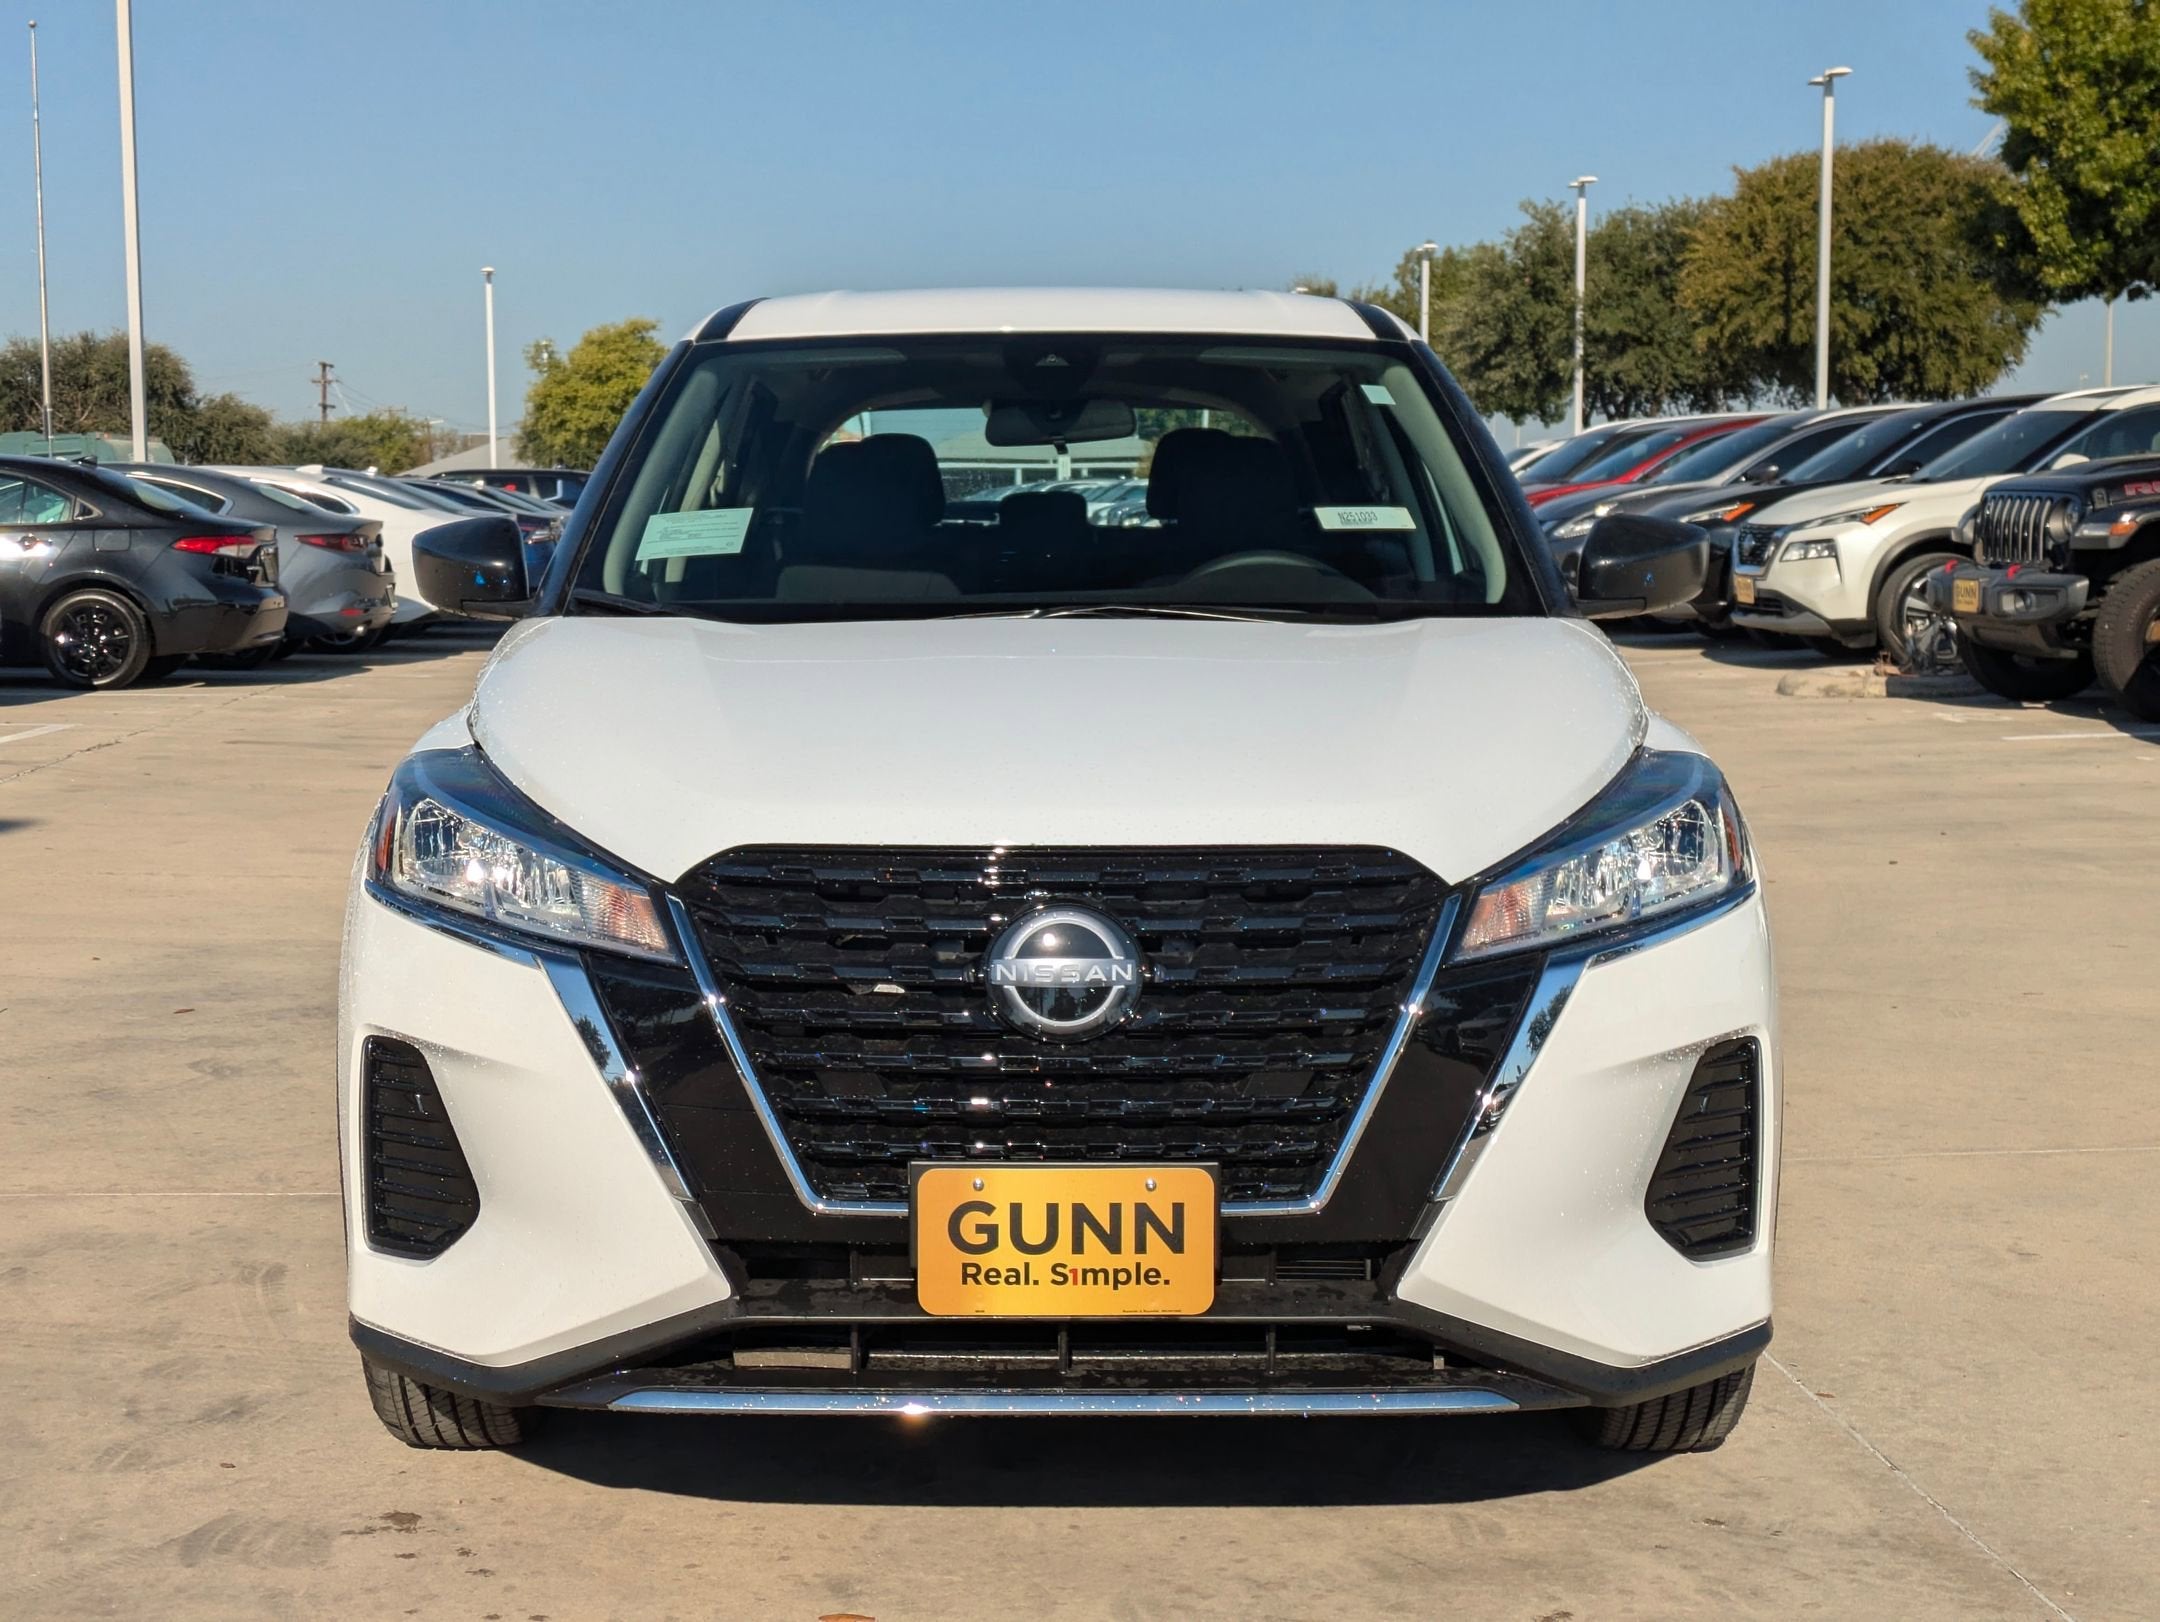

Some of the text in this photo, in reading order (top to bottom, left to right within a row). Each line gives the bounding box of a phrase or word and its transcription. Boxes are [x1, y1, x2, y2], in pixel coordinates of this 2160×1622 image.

[995, 963, 1133, 982] NISSAN
[948, 1201, 1185, 1255] GUNN
[961, 1263, 1040, 1286] Real.
